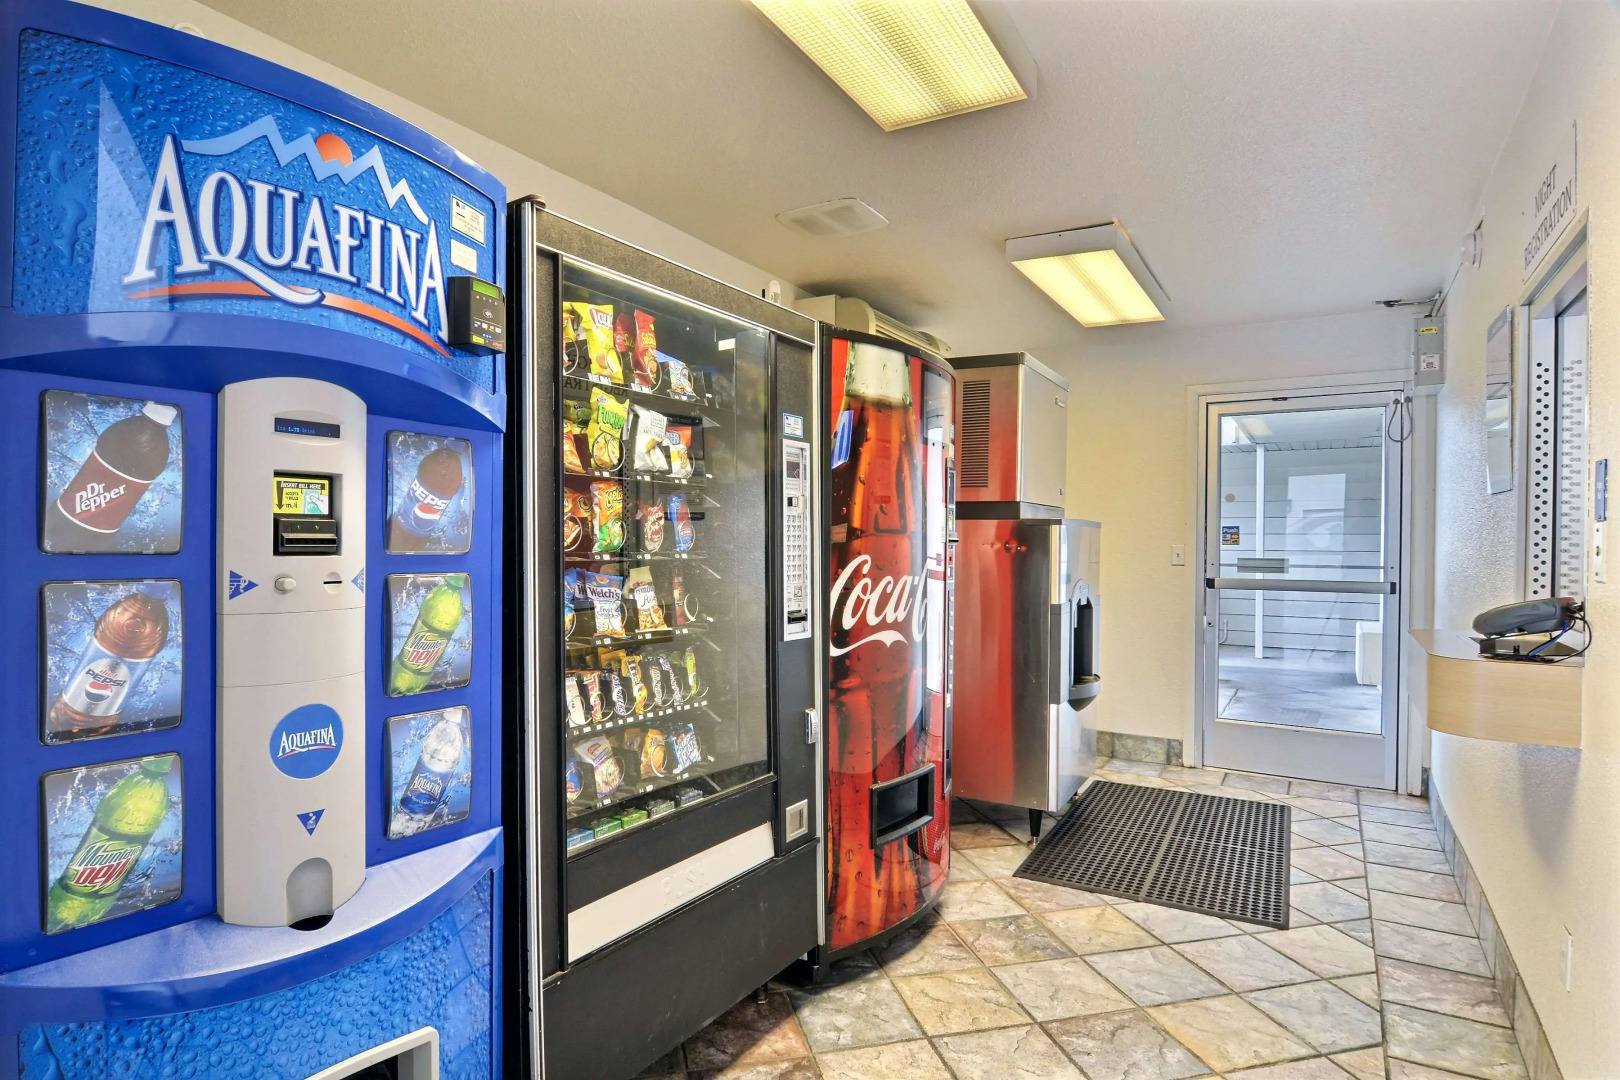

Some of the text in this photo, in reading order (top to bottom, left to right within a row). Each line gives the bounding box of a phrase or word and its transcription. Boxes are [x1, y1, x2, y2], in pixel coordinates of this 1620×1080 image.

[1534, 163, 1557, 219] NIGHT
[122, 134, 449, 345] AQUAFINA
[1524, 180, 1573, 270] REGISTRATION
[75, 484, 127, 514] Pepper
[86, 482, 106, 499] Dr
[280, 480, 298, 488] INSERT
[588, 587, 620, 601] Welch's
[85, 668, 127, 687] PEPSI
[277, 723, 336, 758] AQUAFINA
